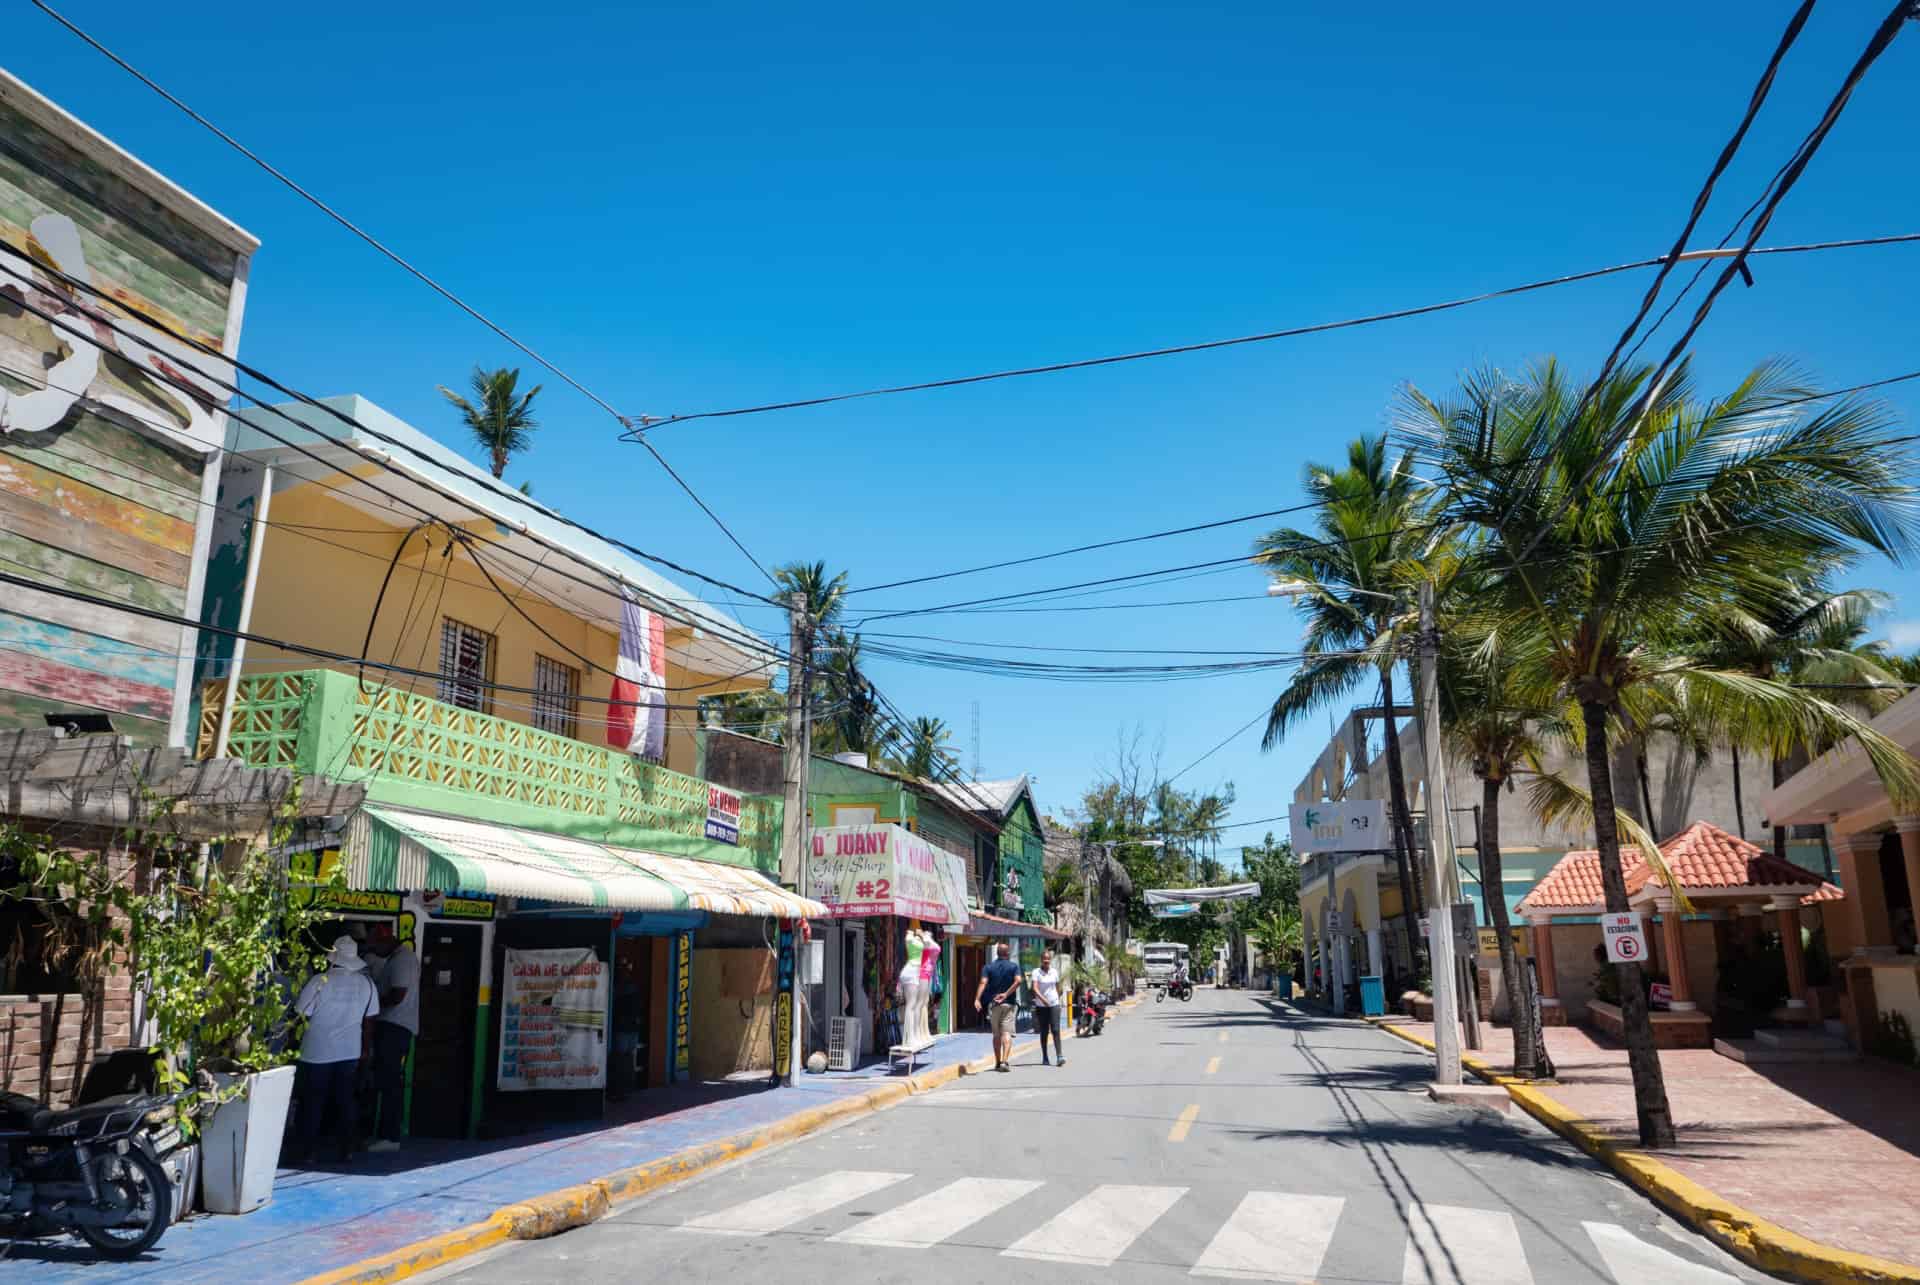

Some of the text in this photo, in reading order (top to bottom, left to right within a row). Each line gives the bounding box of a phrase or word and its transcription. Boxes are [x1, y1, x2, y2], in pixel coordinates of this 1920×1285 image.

[709, 788, 719, 808] SE
[719, 791, 740, 817] VENDE
[836, 832, 888, 856] JUANY
[813, 859, 843, 877] Gift
[849, 856, 887, 874] Shop
[855, 879, 891, 899] #2
[1617, 917, 1631, 925] NO
[512, 961, 602, 977] CASA DE CAMBIO
